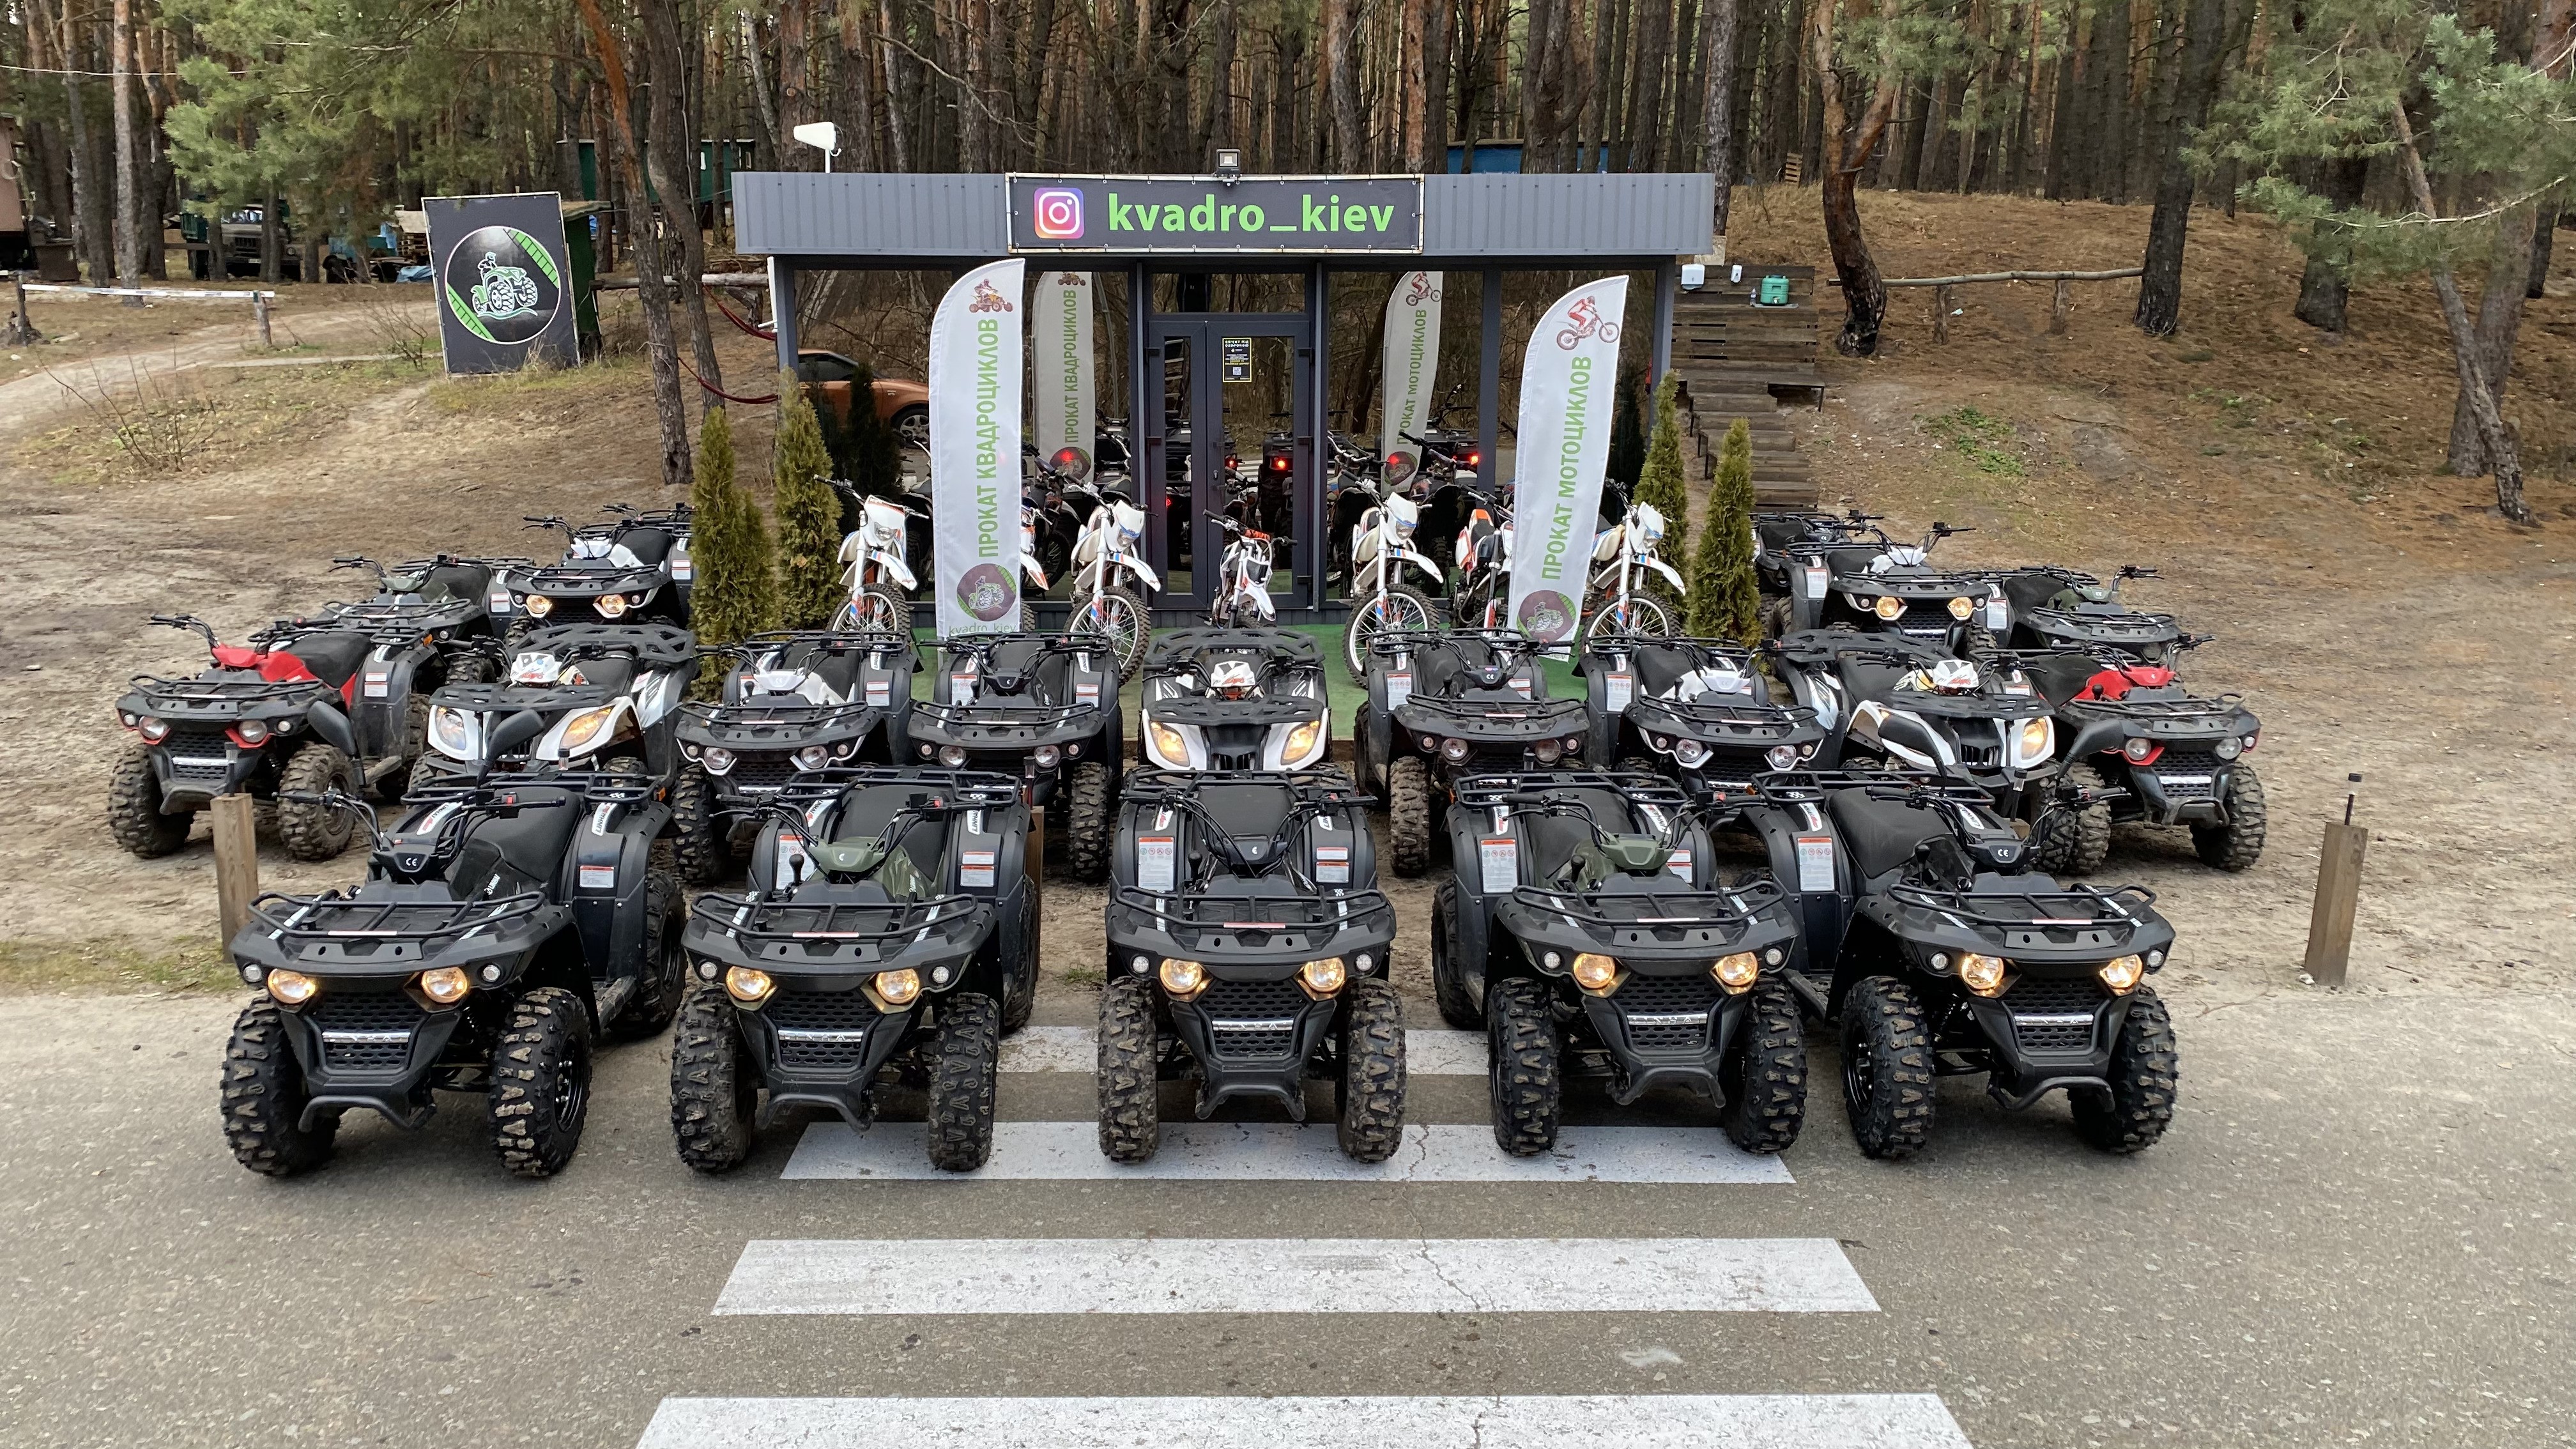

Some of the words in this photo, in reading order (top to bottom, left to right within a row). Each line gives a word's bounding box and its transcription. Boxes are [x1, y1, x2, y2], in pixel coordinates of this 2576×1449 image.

[1108, 194, 1395, 233] kvadro_kiev
[1063, 289, 1080, 392] КВАДРОЦИКЛОВ
[1407, 309, 1427, 395] МОТОЦИКЛОВ
[977, 319, 1001, 478] КВАДРОЦИКЛОВ
[1063, 395, 1078, 443] ПРОКАТ
[1542, 505, 1570, 579] ПРОКАТ
[1559, 357, 1591, 497] МОТОЦИКЛОВ
[977, 486, 998, 557] ПРОКАТ
[406, 857, 418, 866] CE
[1997, 848, 2009, 857] CE
